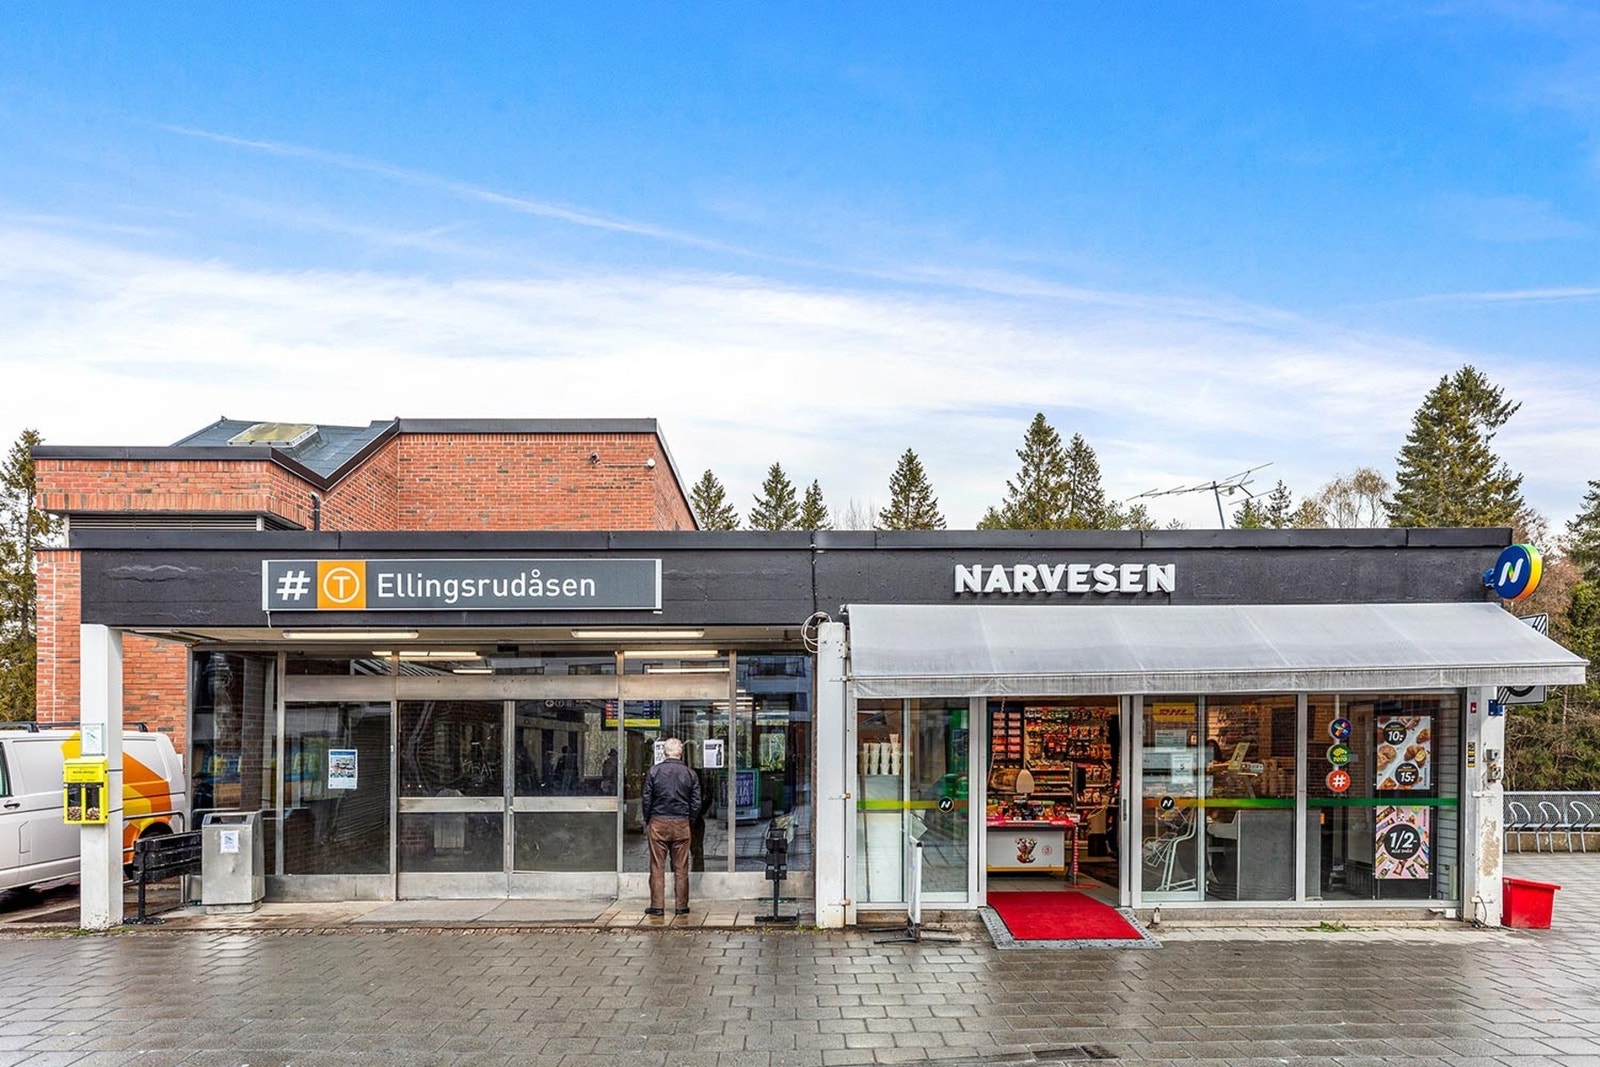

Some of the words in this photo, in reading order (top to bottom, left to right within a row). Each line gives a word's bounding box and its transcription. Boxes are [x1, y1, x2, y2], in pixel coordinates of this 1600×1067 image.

[377, 569, 596, 604] Ellingsrudåsen
[954, 563, 1176, 593] NARVESEN
[1498, 558, 1524, 587] N
[1159, 708, 1189, 716] DHL
